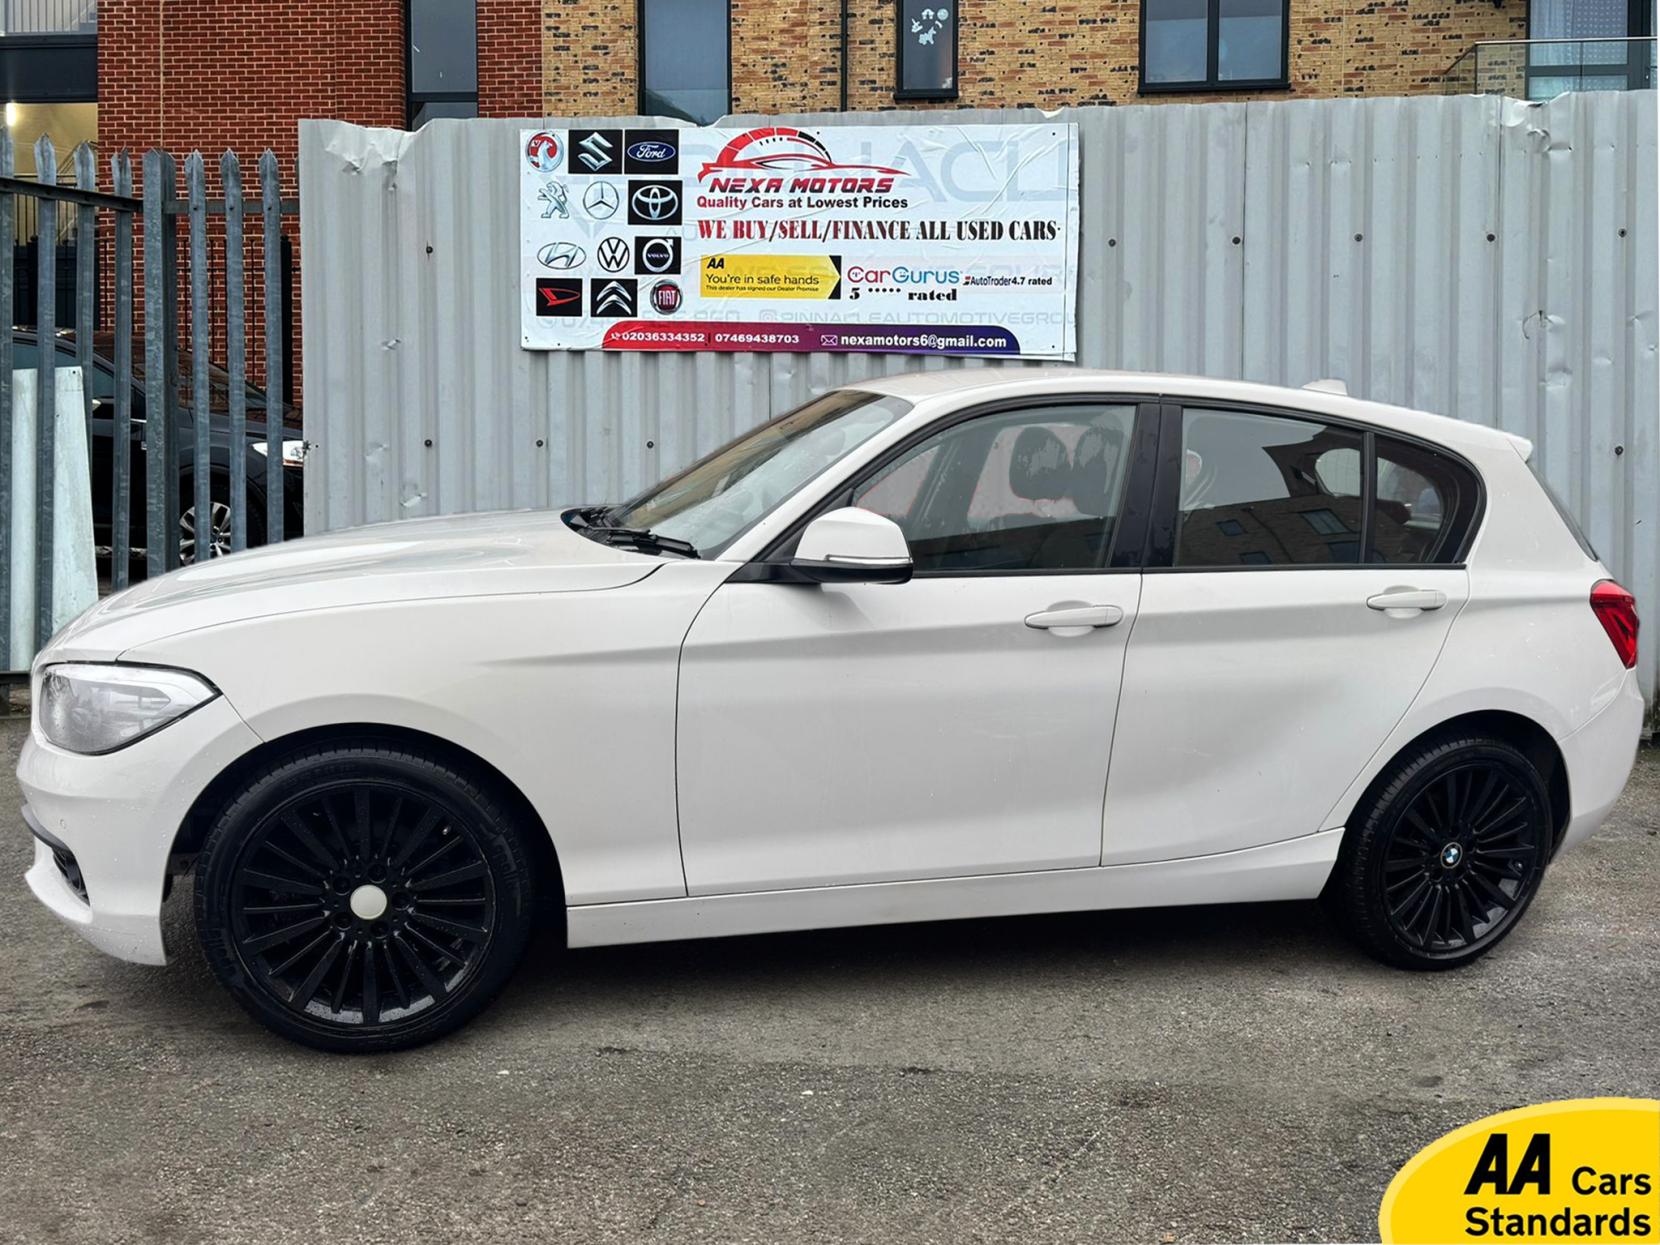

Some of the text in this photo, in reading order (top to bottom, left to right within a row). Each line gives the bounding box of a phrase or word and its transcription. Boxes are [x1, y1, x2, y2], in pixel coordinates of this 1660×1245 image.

[636, 144, 666, 158] Ford
[708, 177, 894, 193] NEXA MOTORS
[697, 195, 908, 210] Quality Cars at Lowest Prices
[697, 220, 727, 239] WE
[733, 220, 910, 242] BUY/SELL/FINANCE
[916, 220, 951, 240] ALL
[956, 220, 1003, 240] USED
[1009, 220, 1057, 240] CARS
[706, 257, 725, 269] AA
[706, 273, 820, 285] You're in safe hands
[847, 266, 960, 284] CarGurus
[1028, 277, 1053, 285] rated
[658, 291, 676, 305] FIAT
[849, 287, 957, 301] 5 rated
[622, 332, 800, 344] 02036334352 07469438703
[841, 334, 1007, 349] nexamotors6@gmail.com
